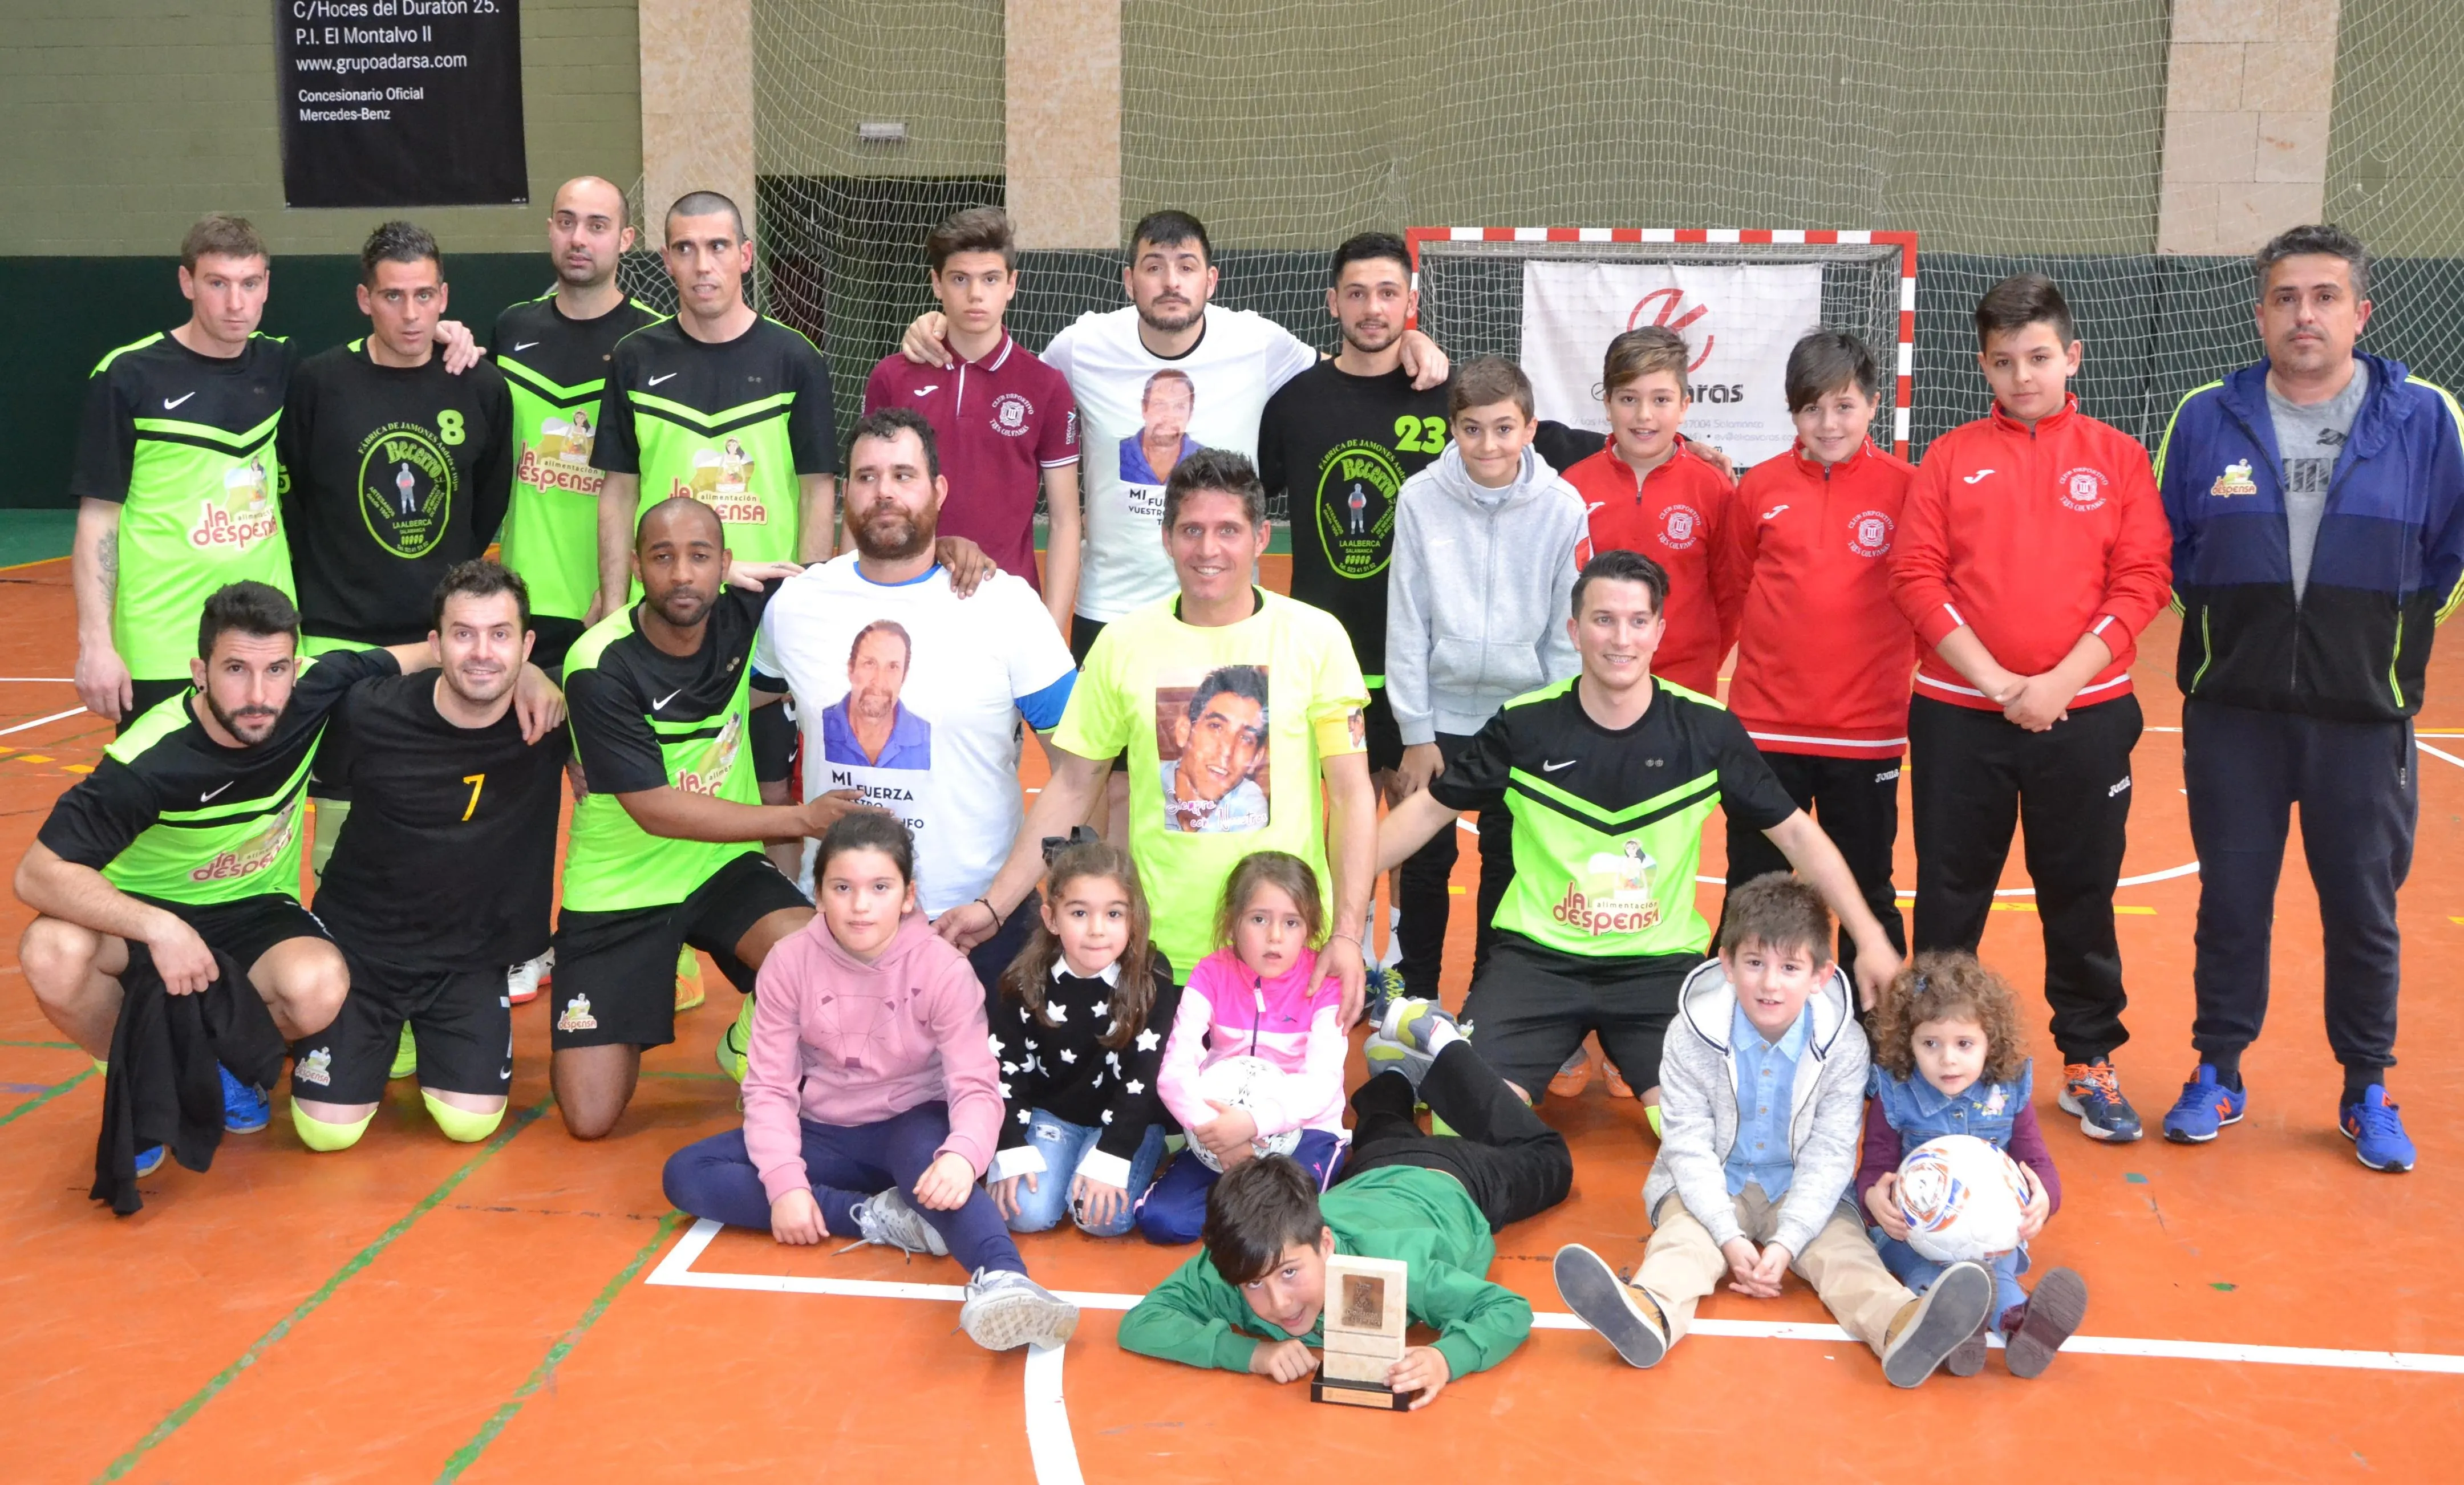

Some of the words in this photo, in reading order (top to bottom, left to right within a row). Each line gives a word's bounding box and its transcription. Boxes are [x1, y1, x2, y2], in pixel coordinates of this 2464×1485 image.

[293, 1, 368, 20] C/Hoces
[372, 0, 398, 15] del
[402, 0, 468, 15] Duratón
[295, 27, 320, 45] P.I.
[325, 27, 339, 44] El
[343, 26, 418, 44] Montalvo
[295, 53, 468, 74] www.grupoadarsa.com
[298, 88, 383, 103] Concesionario
[386, 87, 424, 100] Oficial
[299, 107, 391, 121] Mercedes-Benz
[400, 422, 439, 444] JAMONES
[437, 409, 465, 445] 8
[1394, 415, 1446, 454] 23
[383, 440, 443, 478] Becerro
[1347, 439, 1358, 448] DE
[1359, 440, 1396, 462] JAMONES
[544, 460, 598, 474] alimentación
[1340, 458, 1397, 499] Becerro
[1129, 488, 1146, 500] MI
[401, 518, 433, 528] ALBERCA
[832, 769, 852, 786] MI
[461, 773, 485, 821] 7
[856, 784, 914, 801] FUERZA
